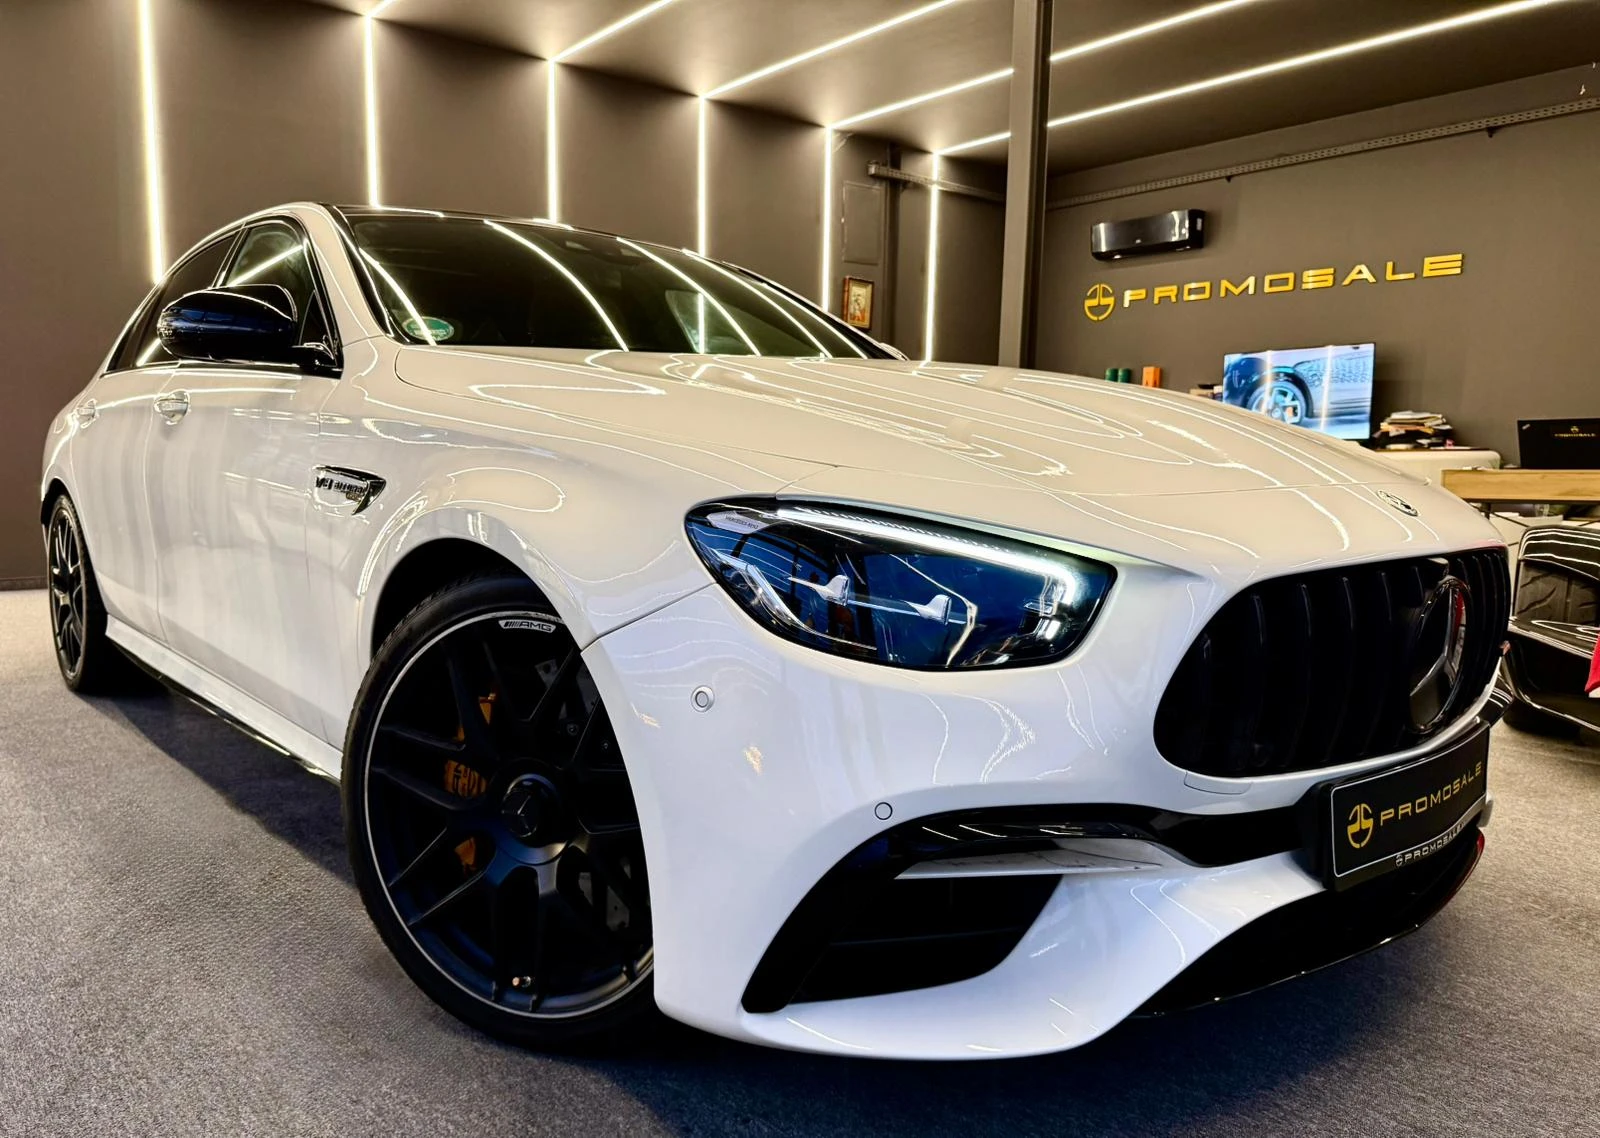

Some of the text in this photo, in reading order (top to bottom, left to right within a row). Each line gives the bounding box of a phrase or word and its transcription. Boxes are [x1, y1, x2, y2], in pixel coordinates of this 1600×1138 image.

[1122, 253, 1464, 308] PROMOSALE
[518, 620, 552, 632] AMG
[1380, 761, 1482, 826] PROMOSALE
